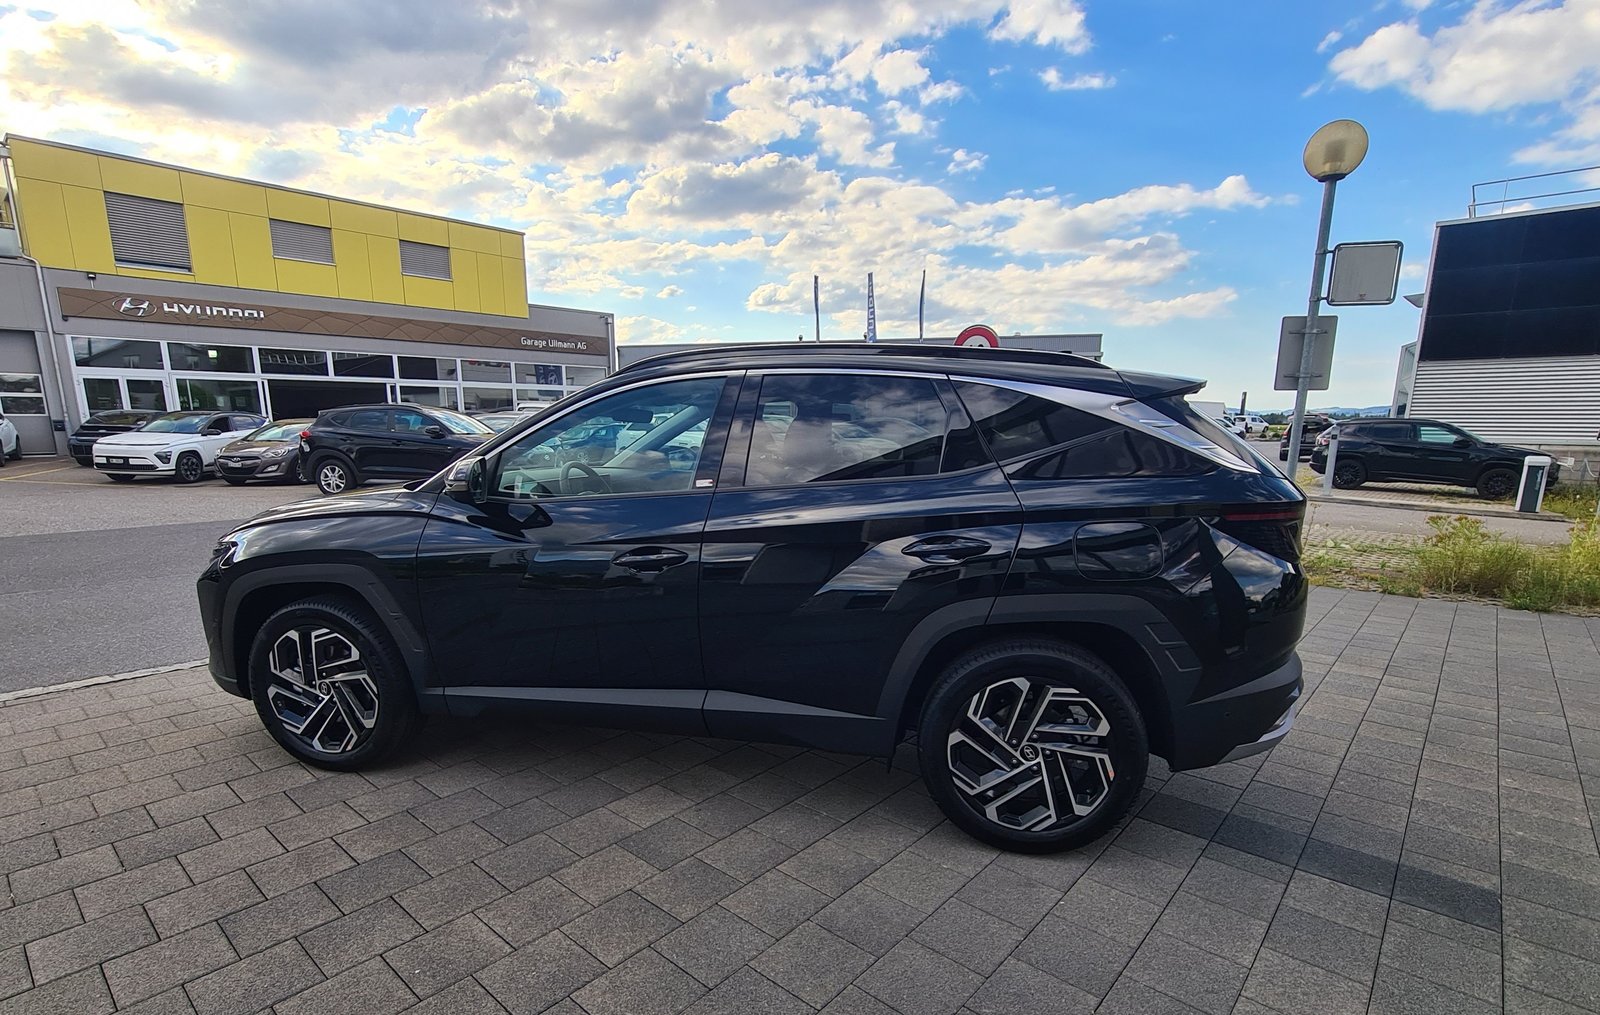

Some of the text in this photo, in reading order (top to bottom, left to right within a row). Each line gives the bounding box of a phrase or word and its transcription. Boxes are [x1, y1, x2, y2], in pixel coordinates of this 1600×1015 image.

[520, 337, 587, 350] Garage Ullmann AG
